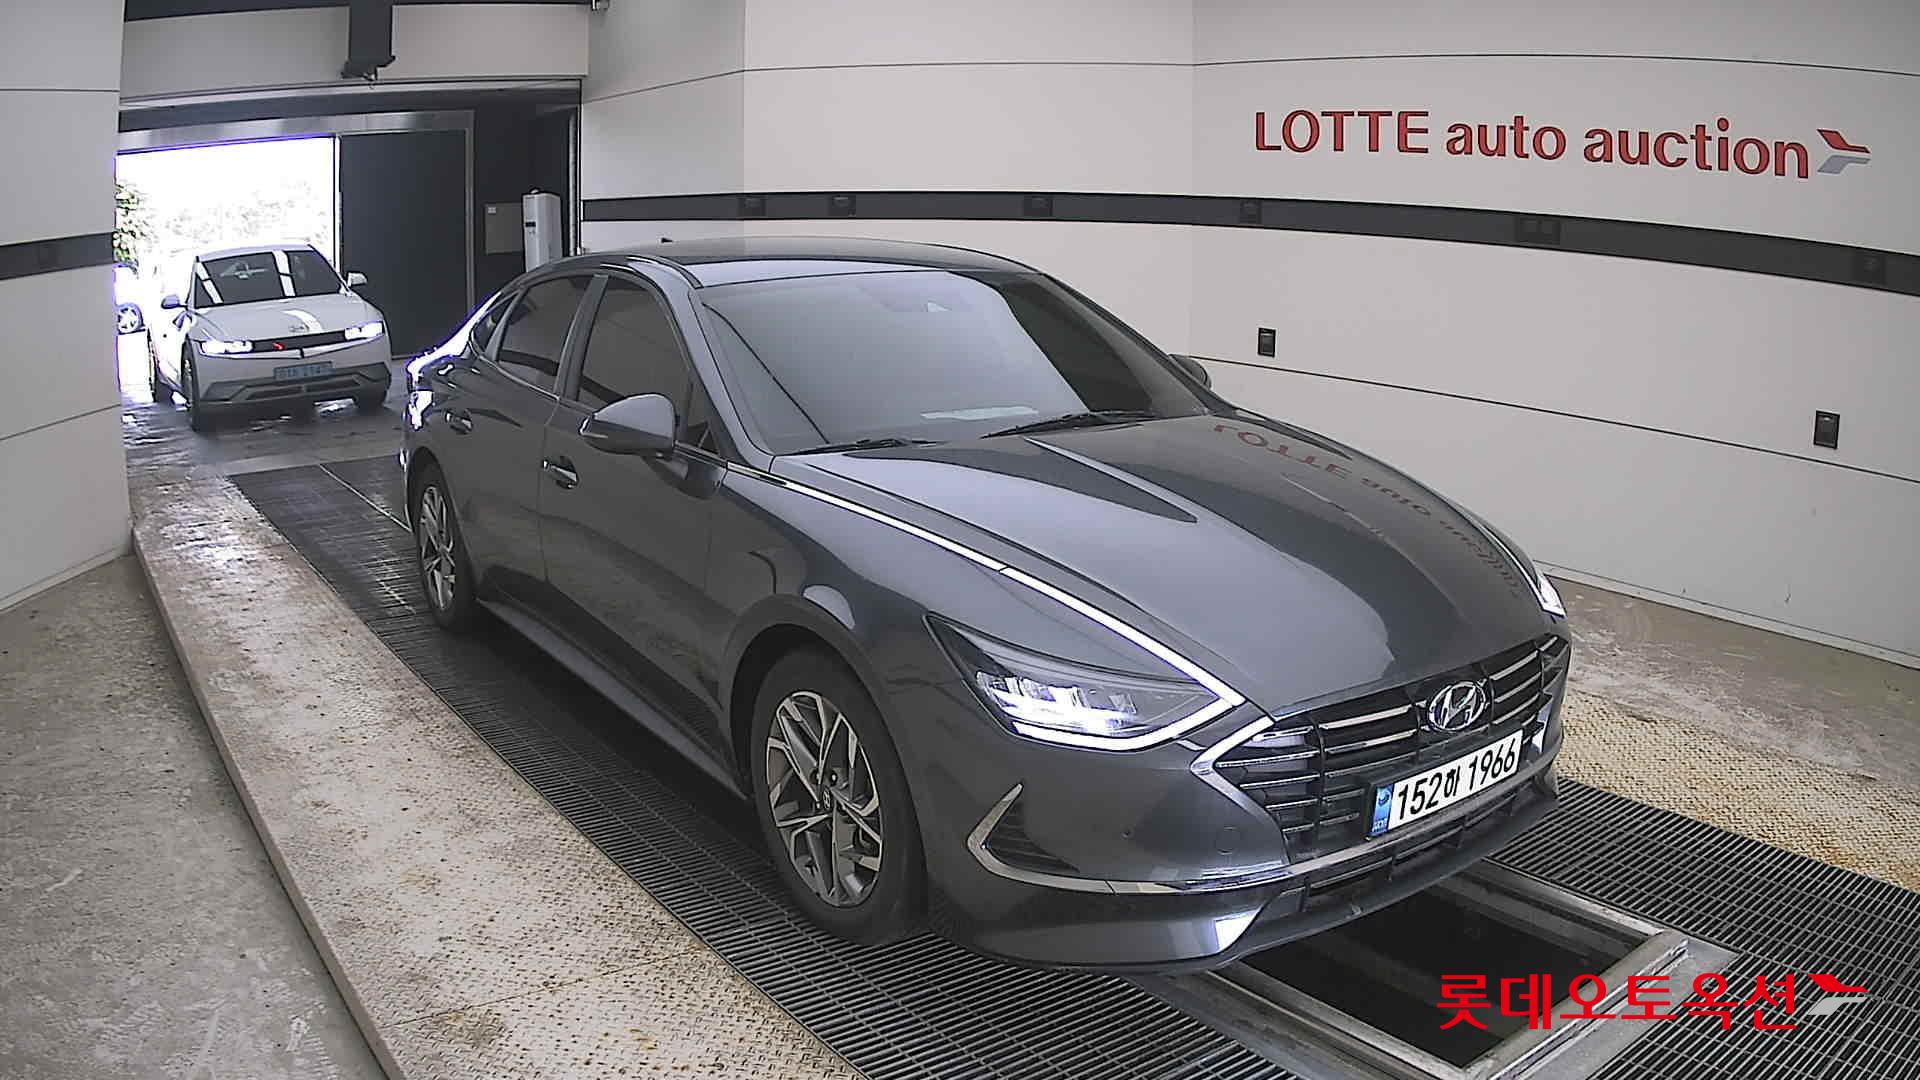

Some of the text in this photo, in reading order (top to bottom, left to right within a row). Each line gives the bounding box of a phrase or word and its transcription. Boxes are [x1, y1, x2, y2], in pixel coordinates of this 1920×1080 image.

[1254, 109, 1809, 179] LOTTE auto auction
[1468, 737, 1517, 792] 1966
